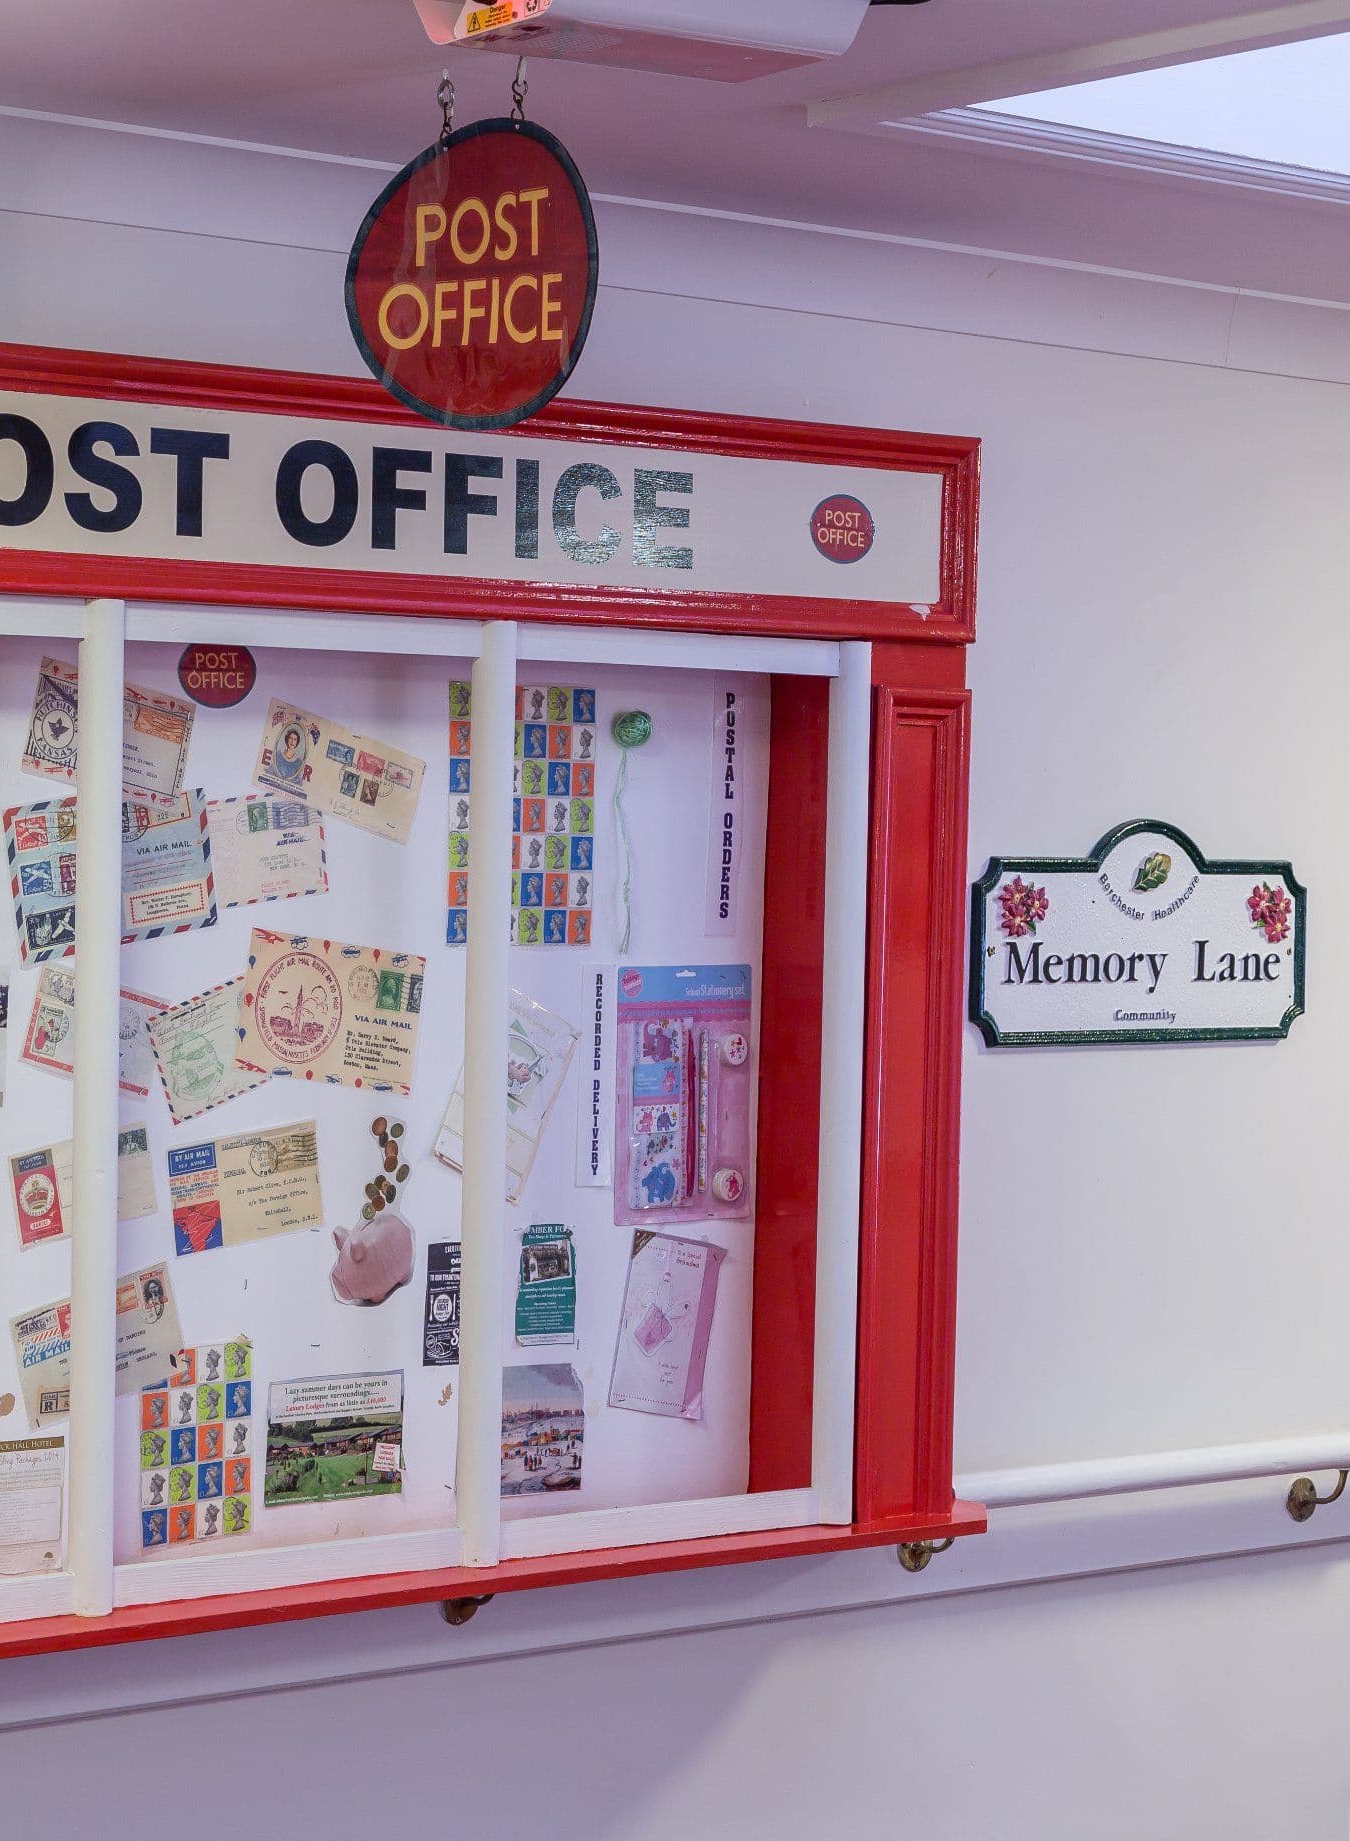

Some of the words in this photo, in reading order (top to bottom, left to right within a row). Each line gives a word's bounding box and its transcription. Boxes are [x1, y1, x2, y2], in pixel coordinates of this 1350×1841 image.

[415, 187, 549, 267] POST
[378, 273, 563, 350] OFFICE
[276, 440, 694, 570] OFFICE
[824, 509, 862, 528] POST
[816, 527, 866, 548] OFFICE
[195, 652, 238, 669] POST
[187, 669, 245, 689] OFFICE
[724, 692, 736, 799] POSTAL
[262, 749, 273, 767] E
[302, 765, 313, 782] R
[137, 847, 150, 855] VIA
[154, 845, 169, 853] AIR
[171, 840, 192, 849] MAIL
[719, 812, 734, 919] ORDERS
[1099, 872, 1145, 921] Barchester
[1153, 874, 1199, 921] Healthcare
[1001, 941, 1168, 994] Memory
[1193, 940, 1282, 982] Lane
[354, 1014, 370, 1023] VIA
[372, 1018, 388, 1026] AIR
[390, 1020, 412, 1030] MAIL
[593, 973, 603, 1071] RECORDED
[1115, 1008, 1176, 1024] Community
[591, 1079, 600, 1176] DELIVERY
[196, 1150, 210, 1158] MAIL
[25, 1354, 42, 1367] AIR
[44, 1345, 70, 1361] MAIL
[284, 1387, 299, 1396] Lazy
[301, 1386, 326, 1394] summer
[328, 1384, 342, 1392] days
[364, 1381, 380, 1390] yours
[44, 1400, 54, 1411] R
[292, 1394, 328, 1404] picturesque
[306, 1402, 325, 1411] Lodges
[12, 1442, 30, 1450] HALL
[31, 1440, 54, 1448] HOTEL
